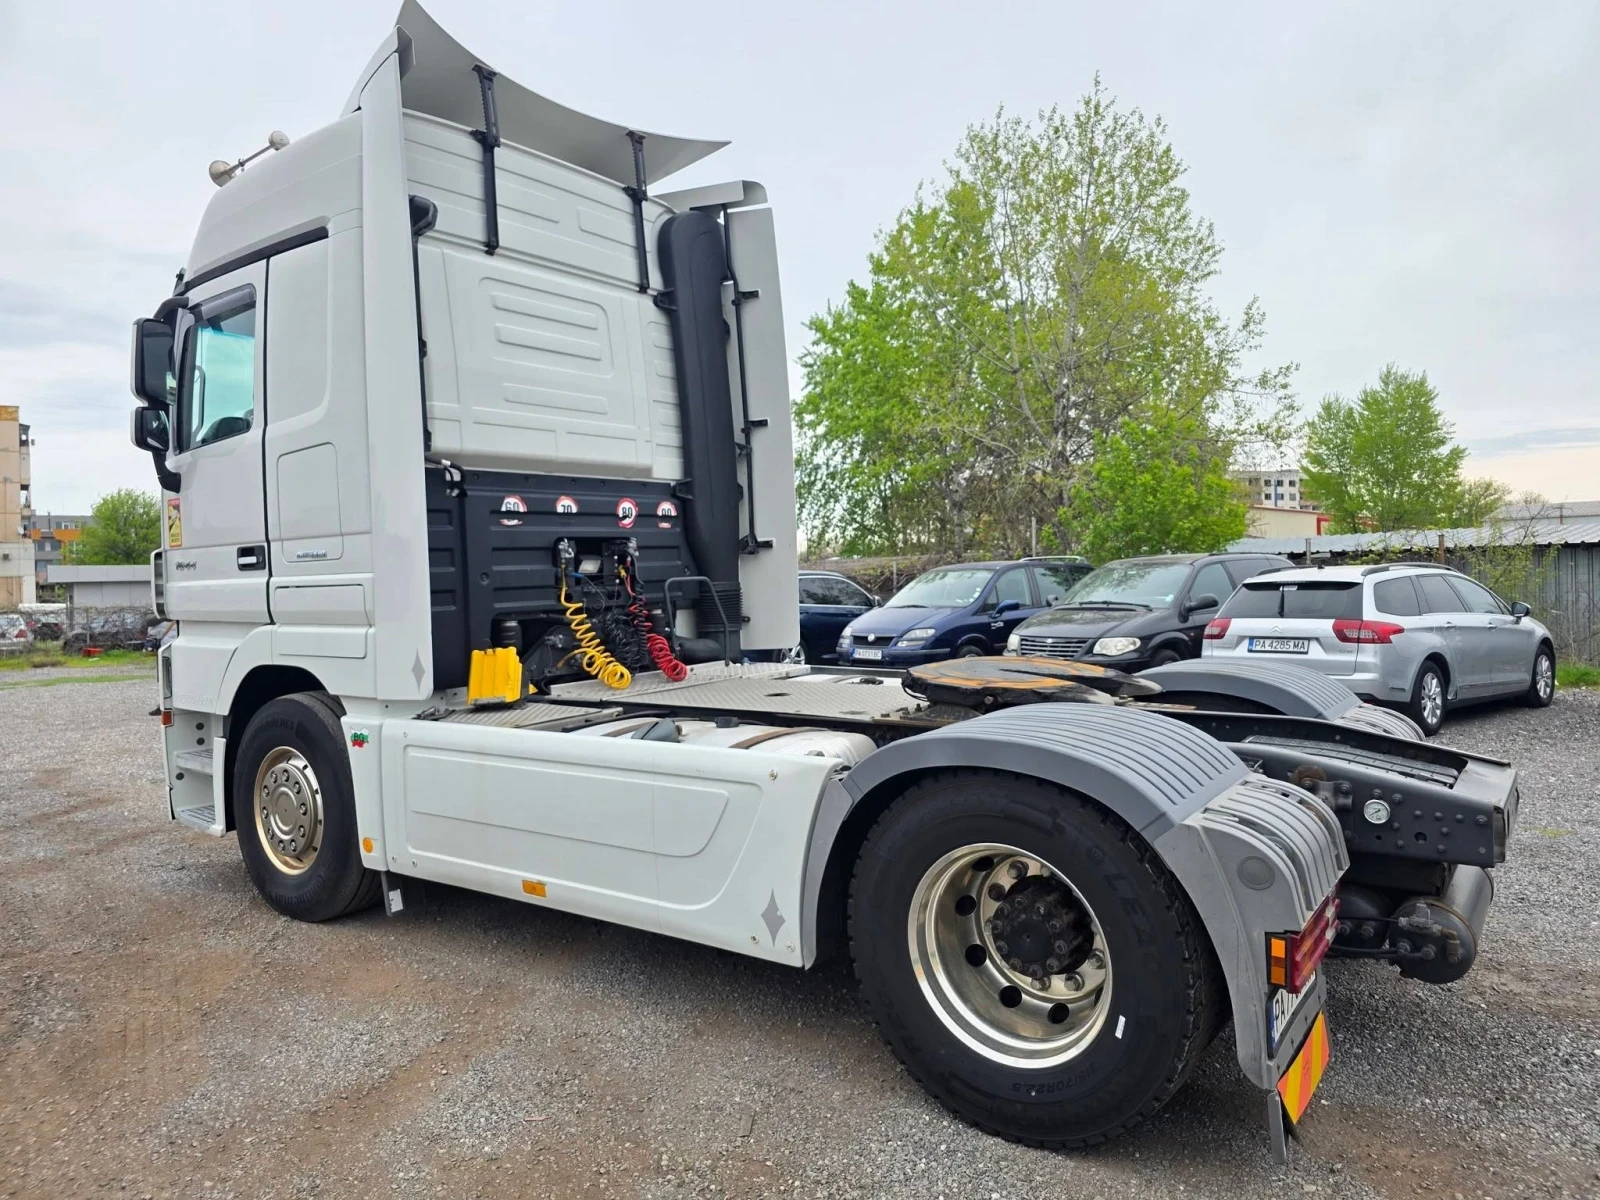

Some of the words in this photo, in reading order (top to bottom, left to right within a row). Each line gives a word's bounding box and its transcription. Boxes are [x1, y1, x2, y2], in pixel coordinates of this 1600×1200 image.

[1253, 639, 1267, 650] PA
[1268, 639, 1291, 650] 4285
[1292, 640, 1306, 651] MA
